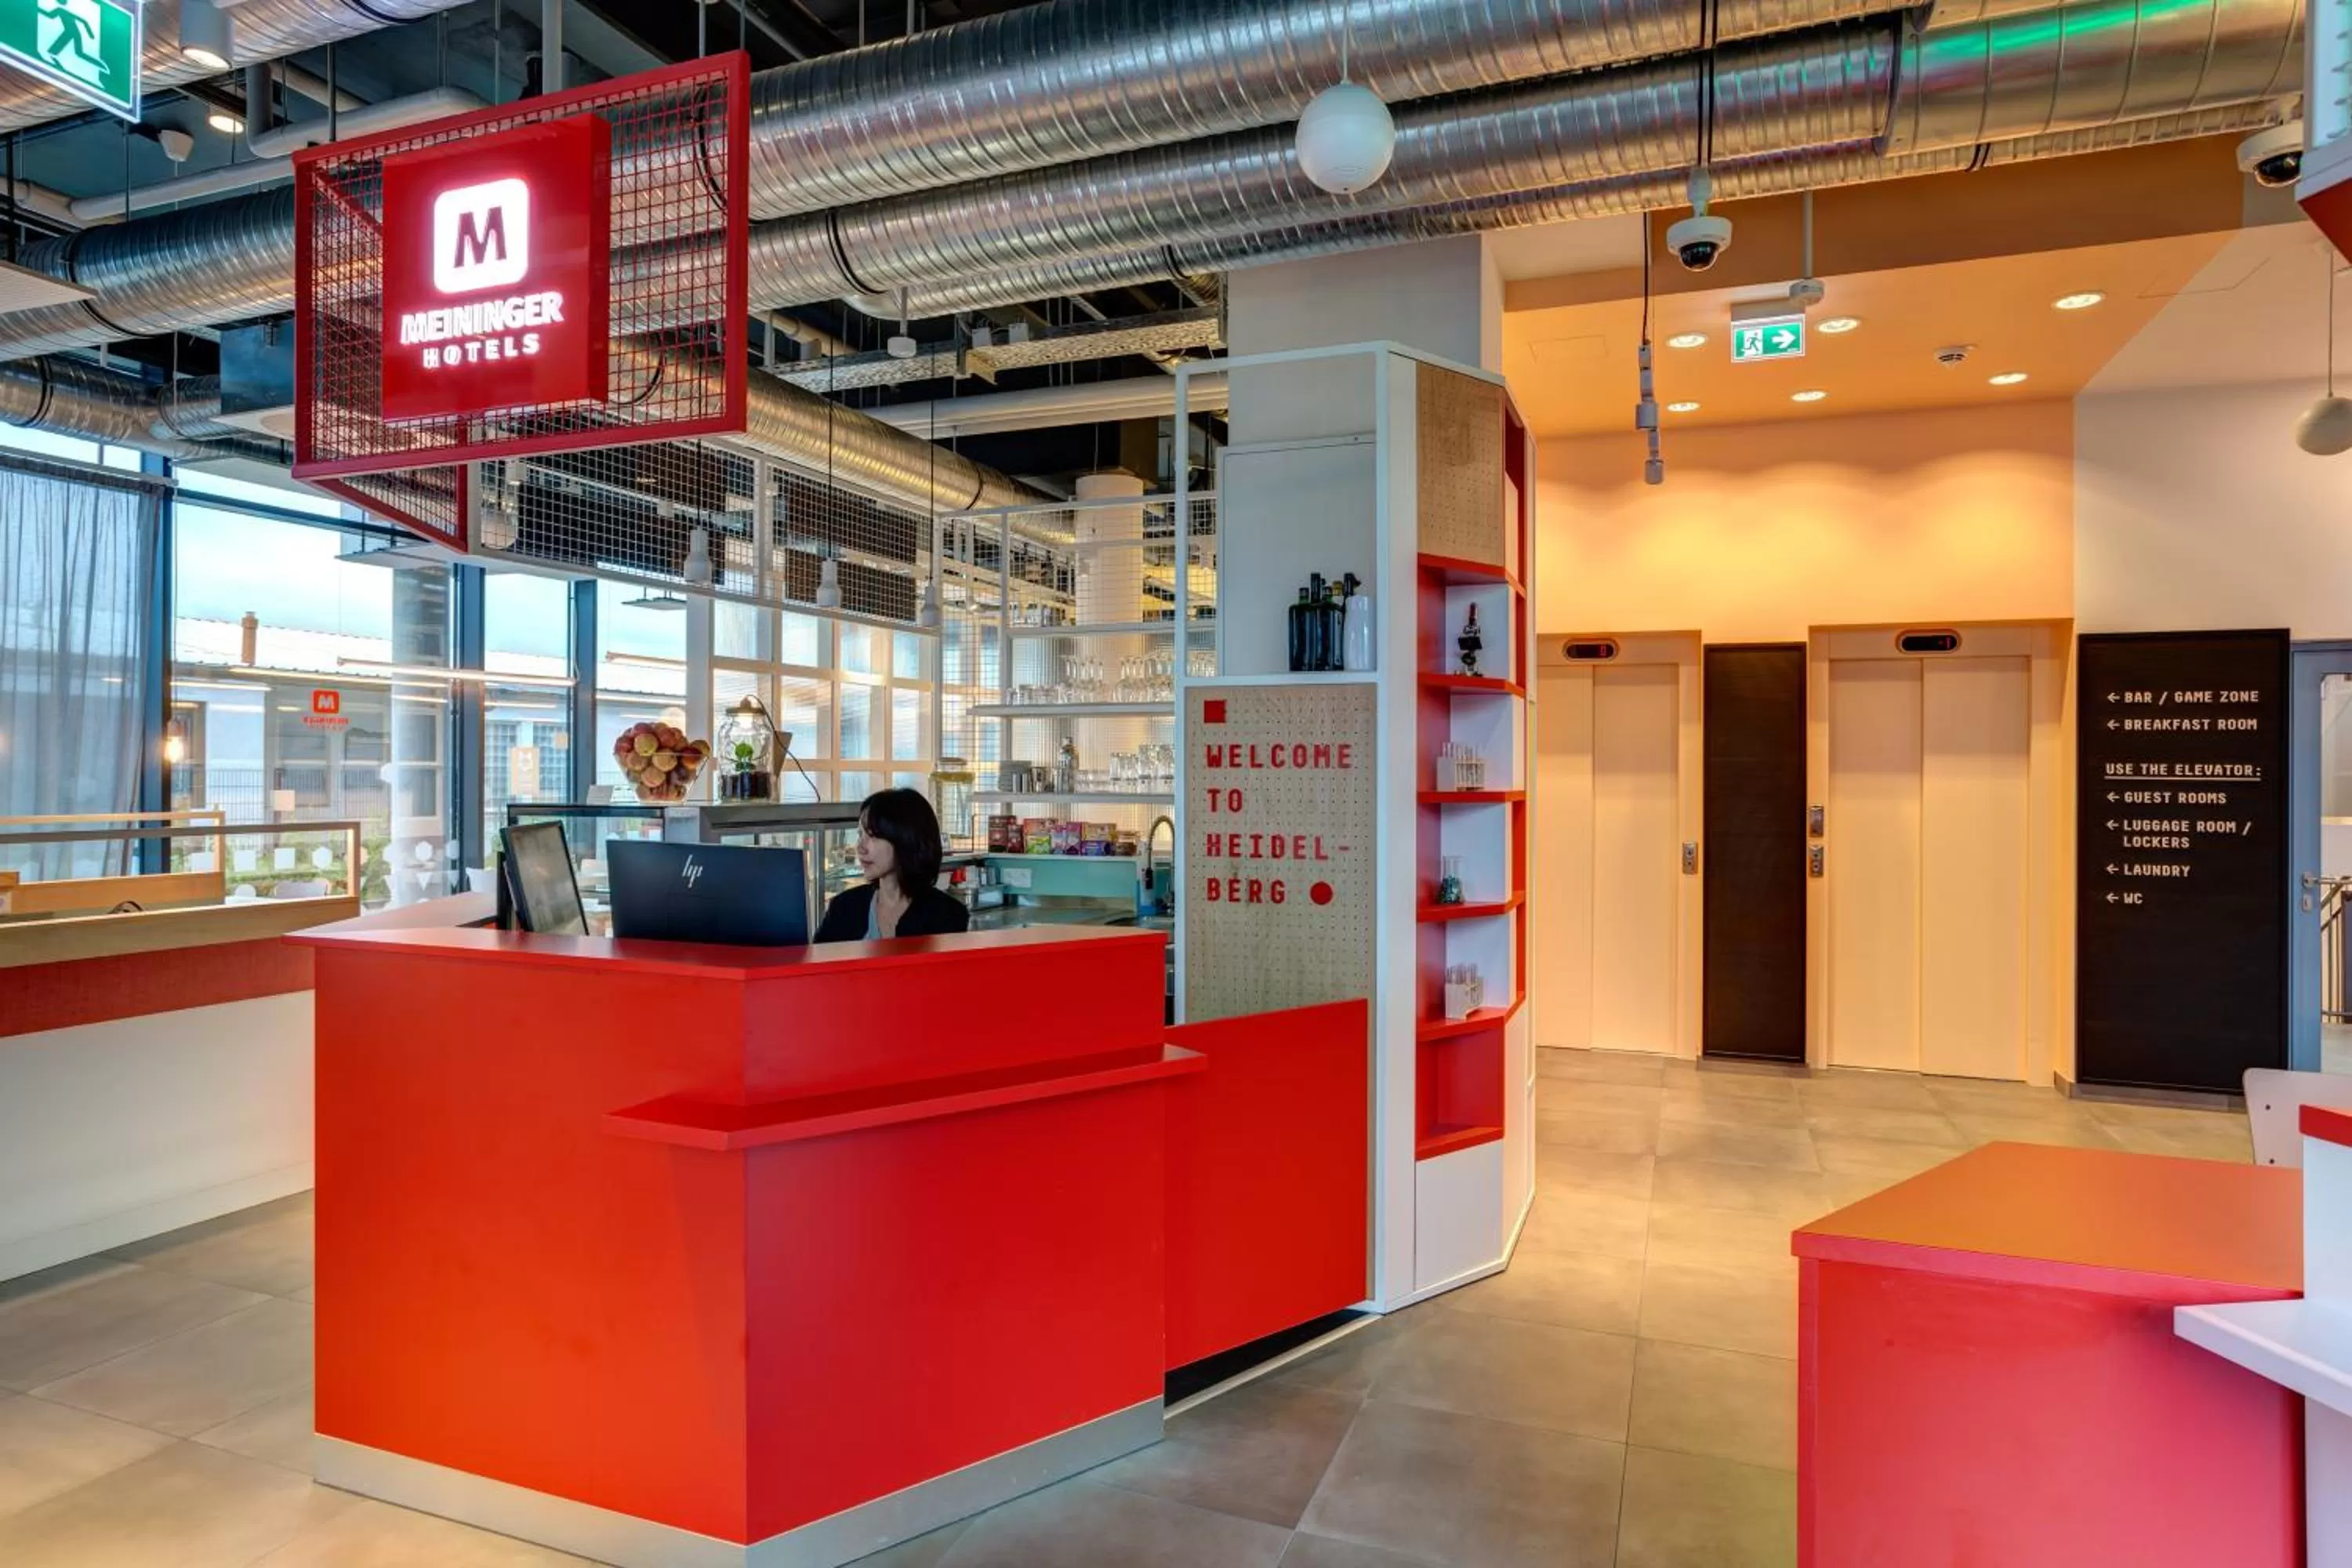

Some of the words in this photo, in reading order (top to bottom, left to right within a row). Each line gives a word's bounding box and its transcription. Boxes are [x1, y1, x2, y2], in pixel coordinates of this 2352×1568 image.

[453, 205, 507, 268] M
[401, 291, 564, 345] MEININGER
[423, 333, 540, 369] HOTELS
[2124, 691, 2152, 703] BAR
[2159, 691, 2168, 706] /
[2174, 691, 2212, 703] GAME
[2220, 691, 2259, 702] ZONE
[2124, 719, 2211, 731] BREAKFAST
[2217, 718, 2258, 731] ROOM
[1205, 743, 1352, 769] WELCOME
[2105, 763, 2133, 775] USE
[2140, 763, 2168, 775] THE
[2175, 764, 2262, 776] ELEVATOR:
[1207, 787, 1243, 813] TO
[2124, 792, 2172, 804] GUEST
[2178, 792, 2227, 804] ROOMS
[2124, 820, 2190, 832] LUGGAGE
[2197, 822, 2237, 833] ROOM
[2242, 822, 2252, 836] /
[1206, 833, 1350, 860] HEIDEL-
[2123, 836, 2190, 848] LOCKERS
[683, 854, 702, 887] hp
[2124, 864, 2190, 877] LAUNDRY
[1207, 877, 1287, 904] BERG
[2124, 892, 2143, 905] WC
